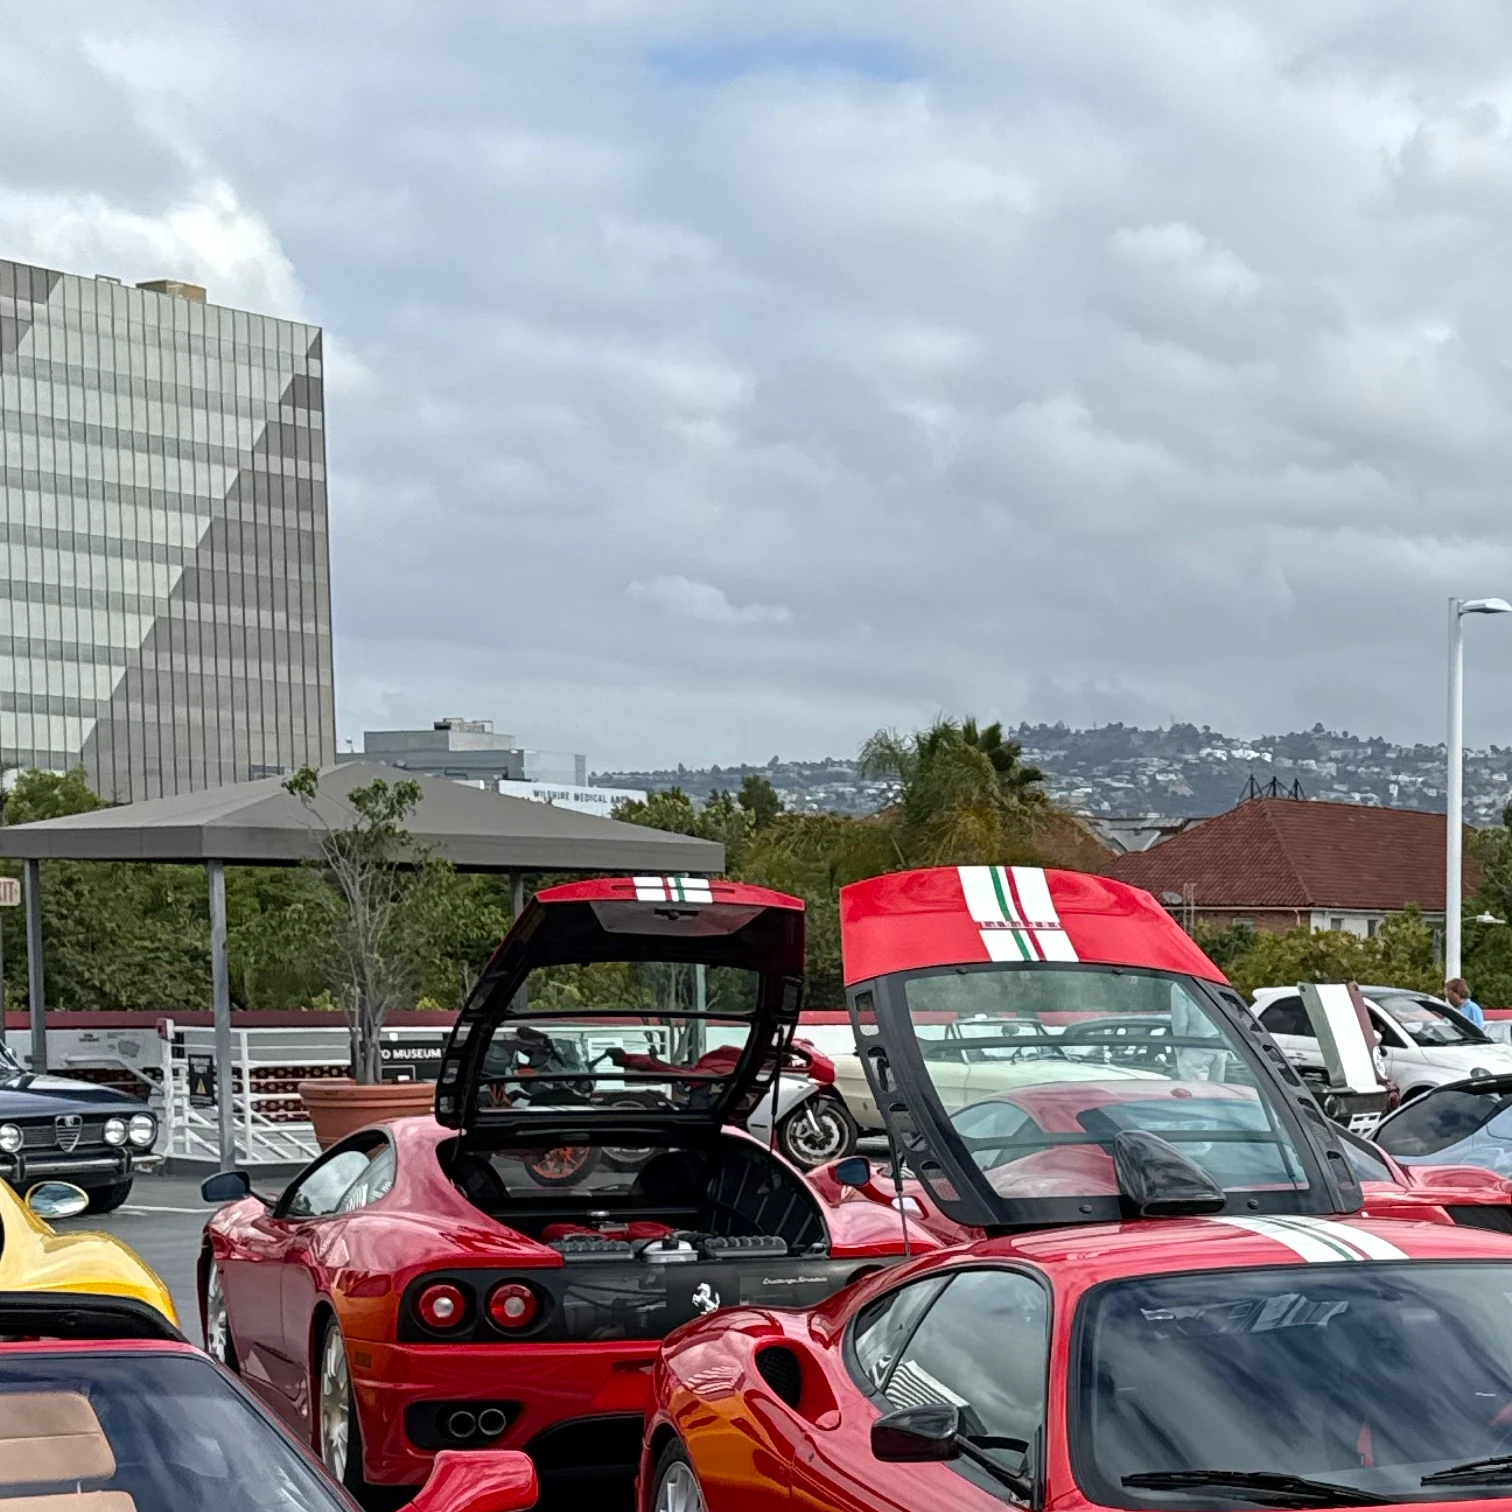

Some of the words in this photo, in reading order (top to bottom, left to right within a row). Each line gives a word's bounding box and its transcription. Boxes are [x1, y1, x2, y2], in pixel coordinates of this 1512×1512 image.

[533, 789, 570, 801] WILSHIRE
[574, 792, 607, 804] MEDICAL
[393, 1048, 442, 1060] MUSEUM
